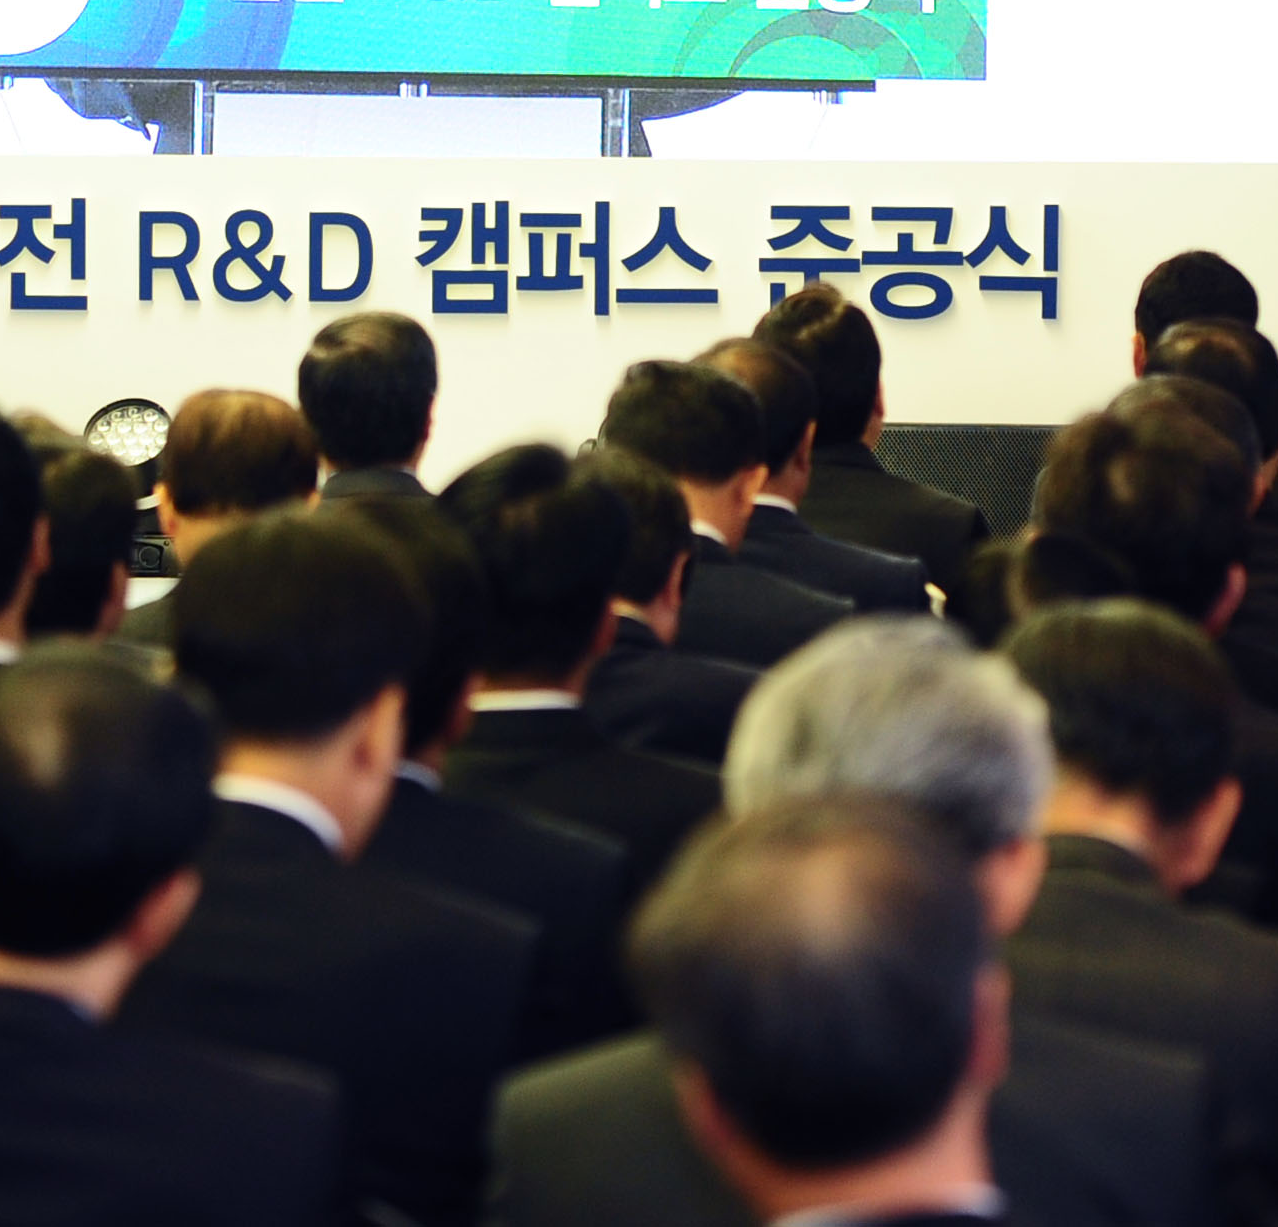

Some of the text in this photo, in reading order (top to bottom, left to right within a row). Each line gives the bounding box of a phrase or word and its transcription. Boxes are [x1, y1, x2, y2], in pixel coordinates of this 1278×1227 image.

[139, 209, 374, 303] R&D
[415, 201, 718, 316] 캠퍼스
[759, 204, 1060, 319] 준공식
